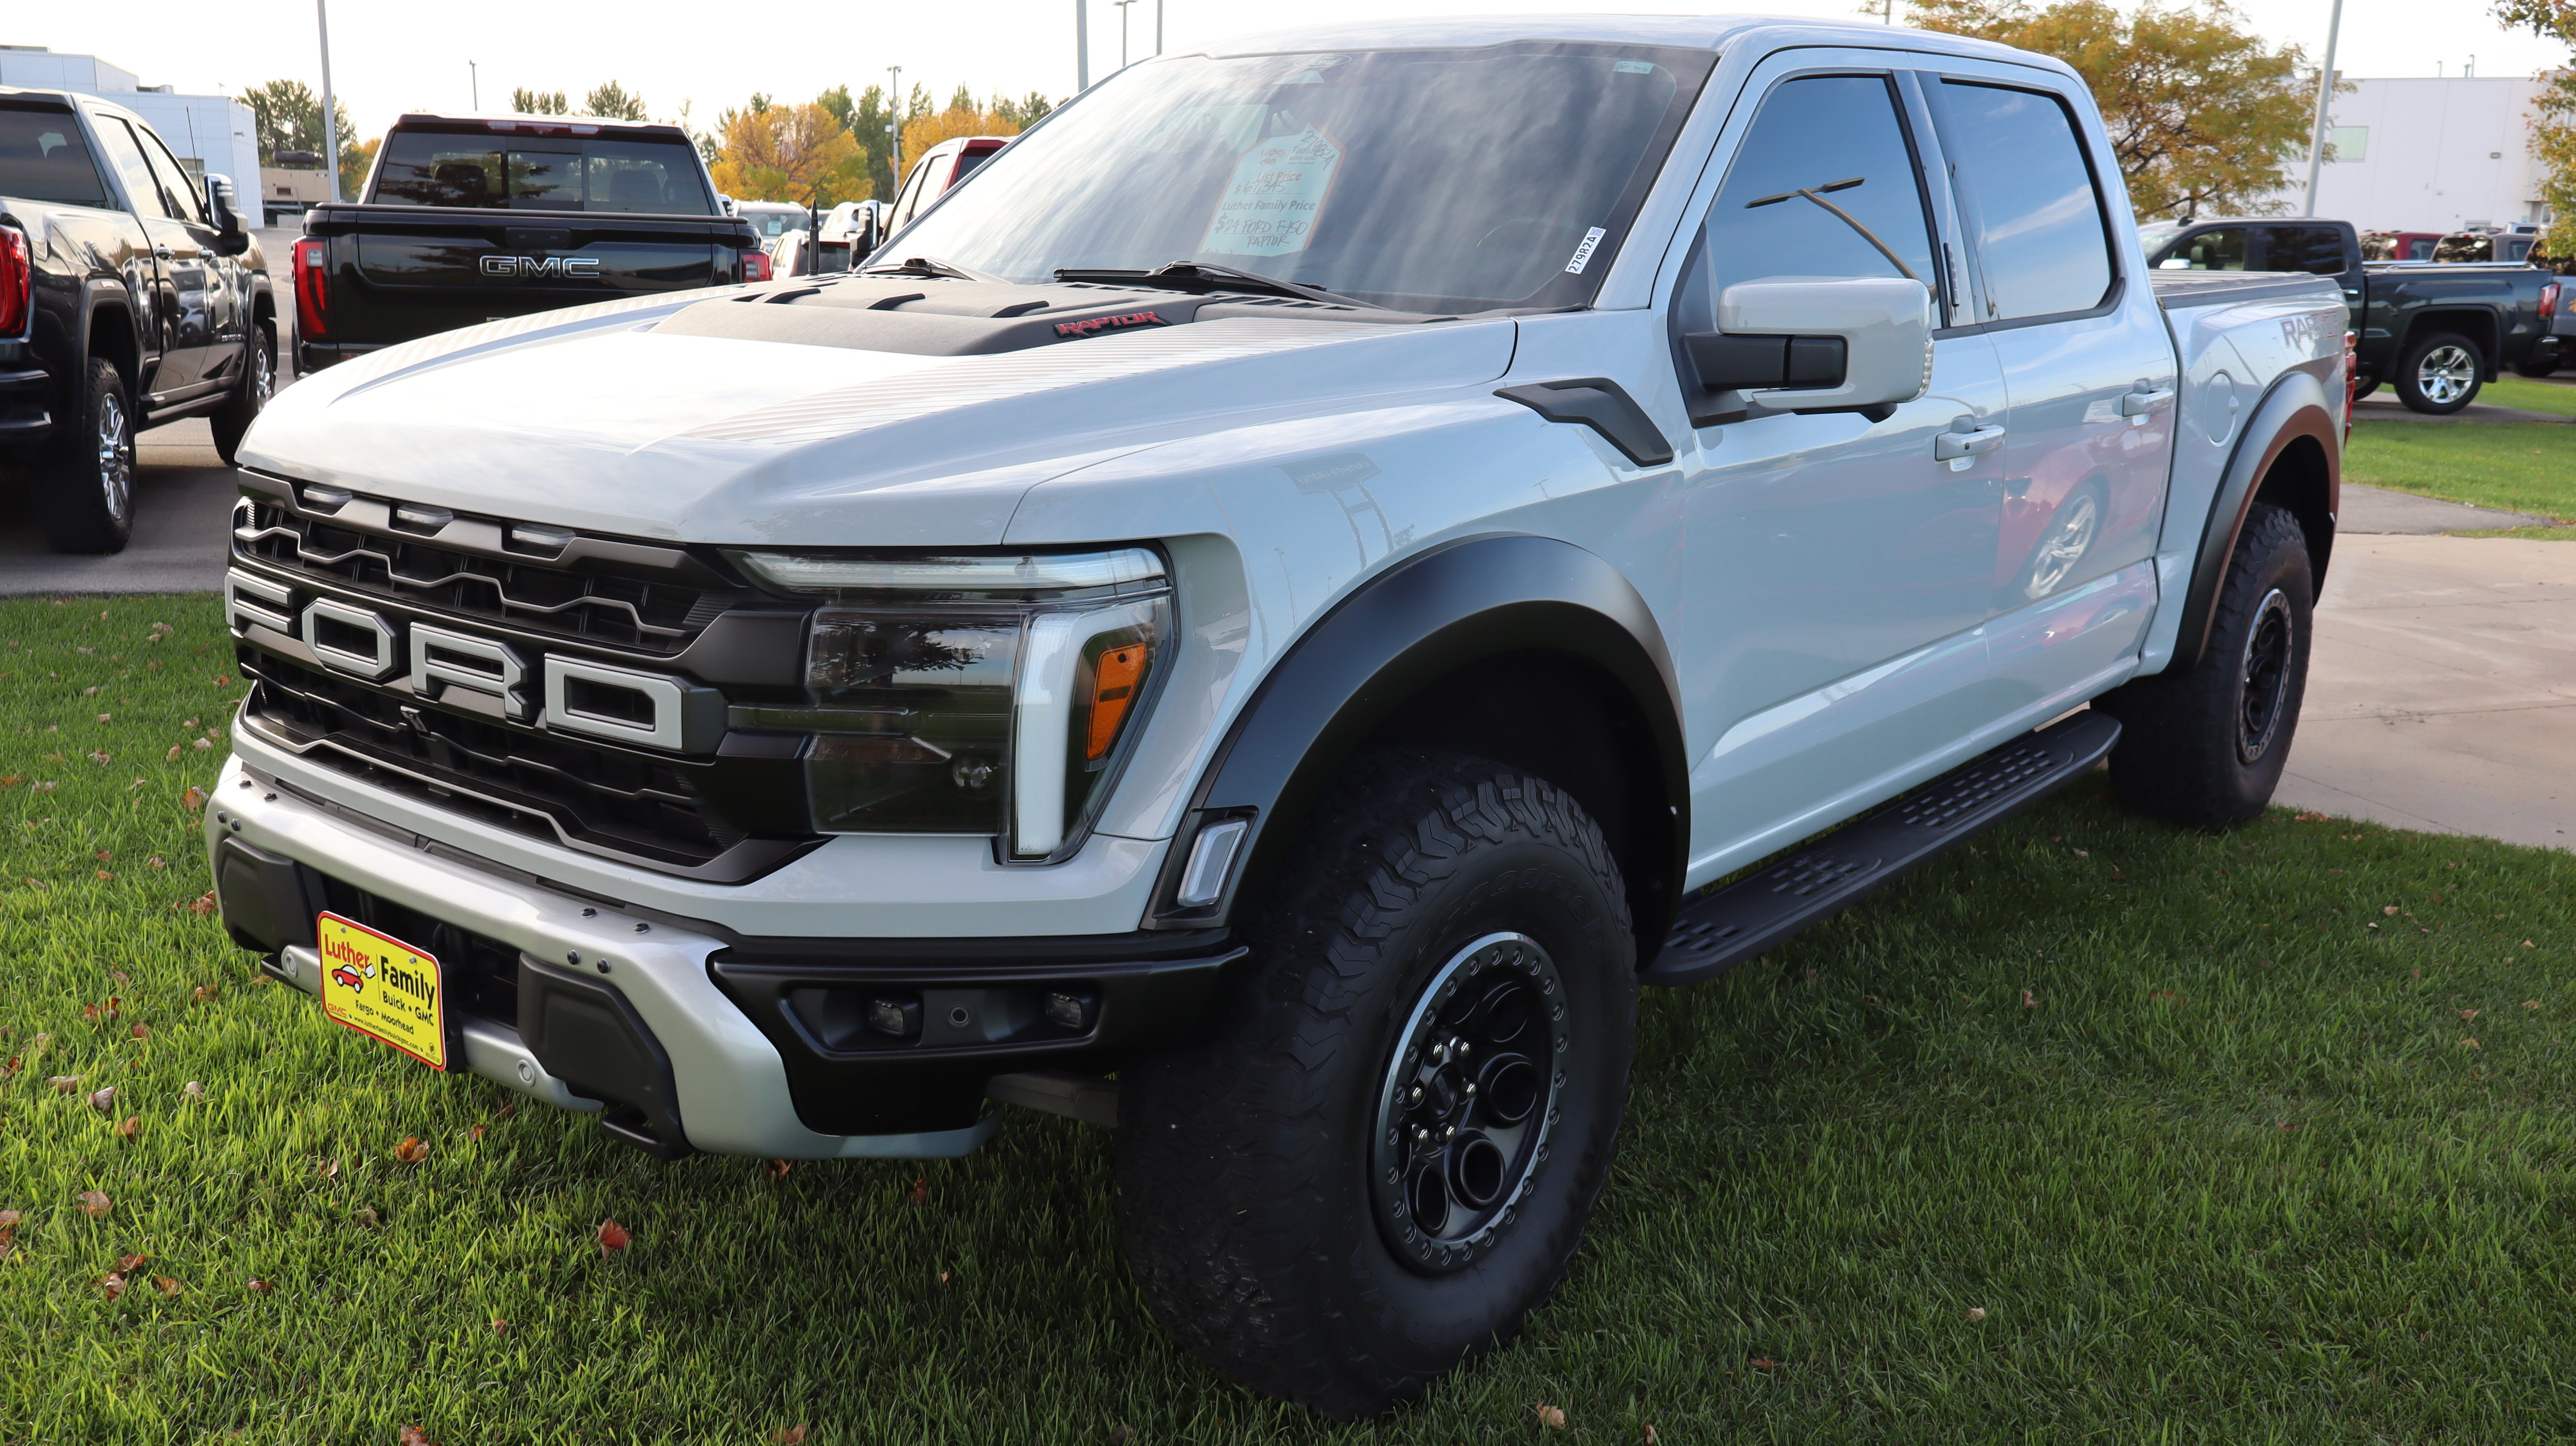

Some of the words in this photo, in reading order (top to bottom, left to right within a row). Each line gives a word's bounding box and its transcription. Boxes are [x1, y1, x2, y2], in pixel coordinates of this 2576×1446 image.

[1260, 147, 1286, 157] Luther
[1256, 172, 1274, 182] List
[1275, 171, 1302, 182] Price
[1235, 184, 1241, 195] $
[1222, 200, 1253, 211] Luther
[1254, 200, 1289, 212] Family
[1289, 200, 1317, 210] Price
[1276, 220, 1309, 235] F-150
[1568, 237, 1597, 272] 27982A
[479, 255, 599, 278] GMC
[1056, 311, 1165, 335] RAPTOR
[225, 567, 683, 749] FORD
[325, 933, 370, 969] Luther
[380, 955, 436, 1011] Family
[328, 1003, 347, 1017] GMC
[356, 999, 374, 1016] Fargo
[381, 1011, 414, 1035] Moorhead
[382, 990, 406, 1013] Buick
[415, 1006, 434, 1027] GMC
[425, 1052, 441, 1064] BUICK
